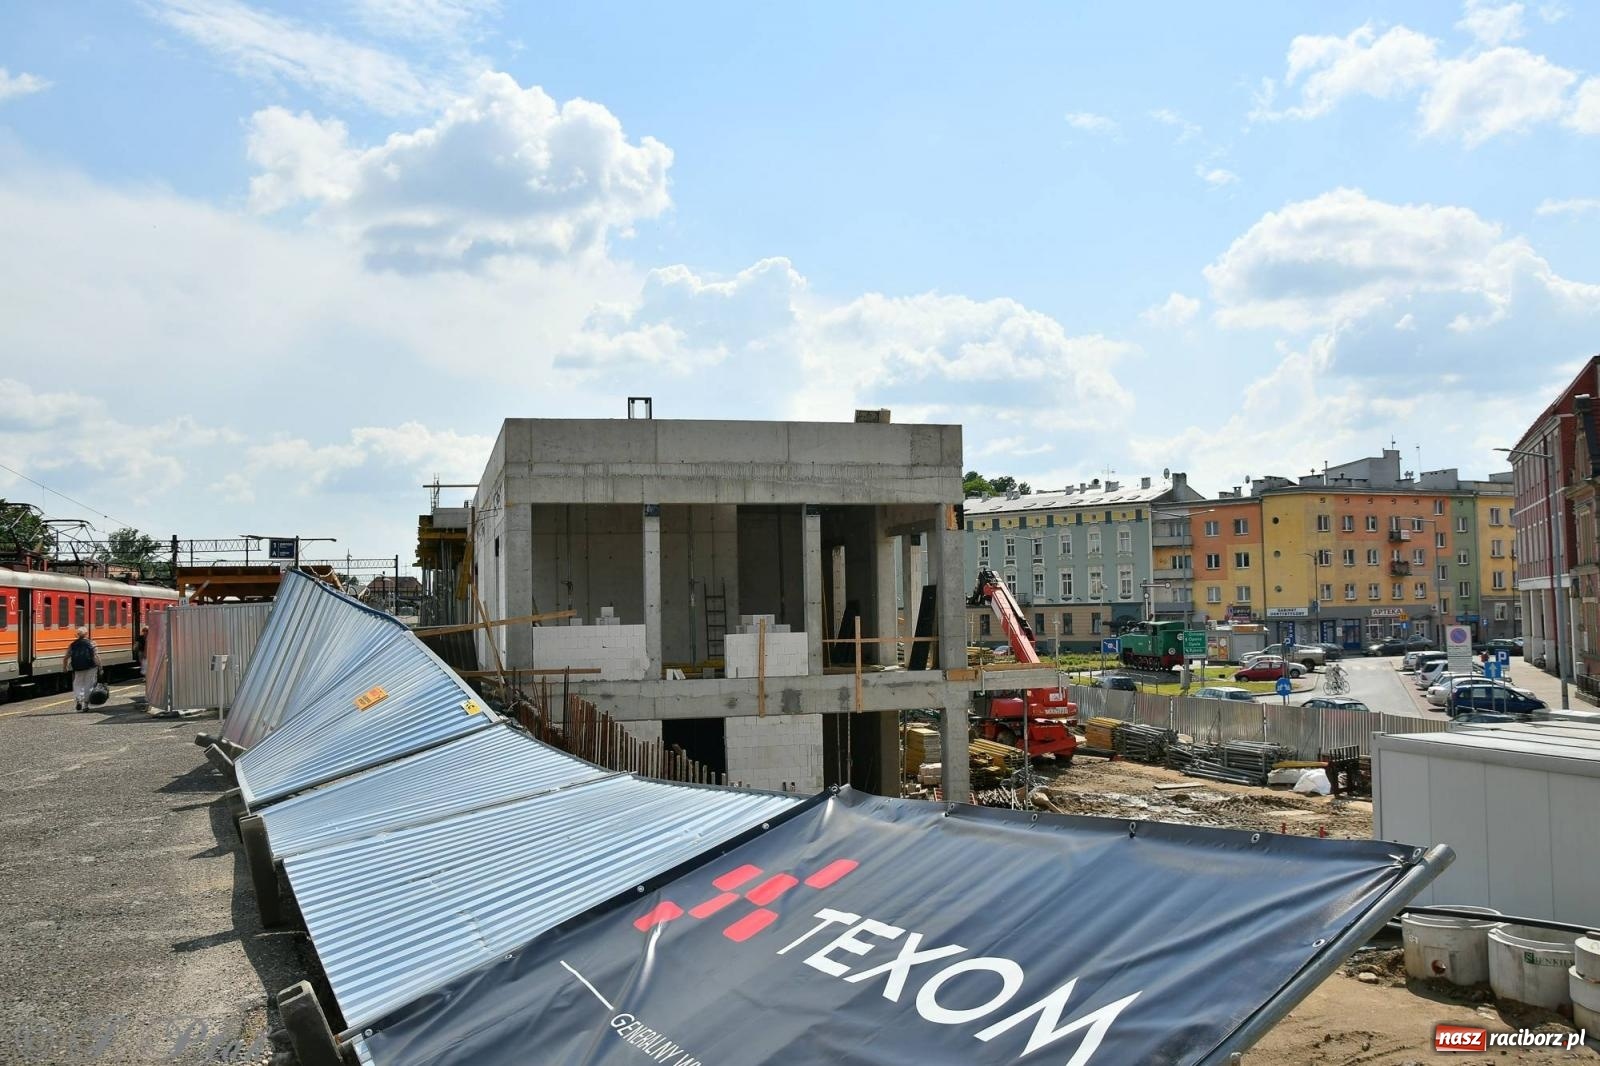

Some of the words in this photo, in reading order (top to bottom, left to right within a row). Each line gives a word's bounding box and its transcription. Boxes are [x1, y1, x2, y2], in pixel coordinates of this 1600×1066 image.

[1498, 651, 1507, 662] P
[776, 908, 1143, 1066] TEXOM
[610, 1013, 684, 1064] GENERALNY
